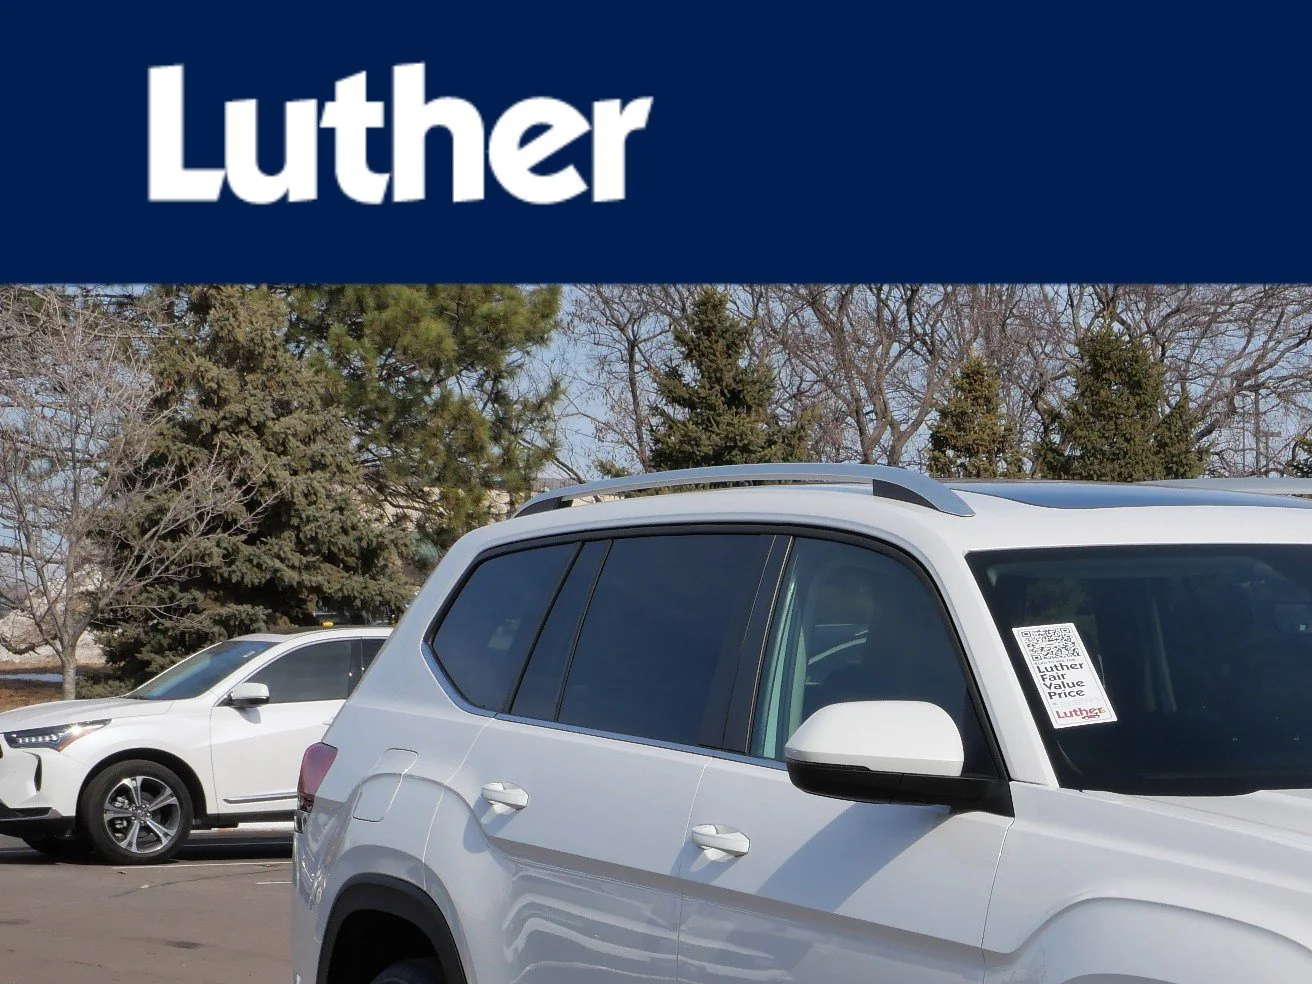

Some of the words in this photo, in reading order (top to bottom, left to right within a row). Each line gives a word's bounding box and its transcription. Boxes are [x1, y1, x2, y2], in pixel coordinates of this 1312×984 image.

[1036, 662, 1084, 674] Luther
[1039, 672, 1067, 683] Fair
[1043, 680, 1086, 691] Value
[1047, 689, 1086, 700] Price
[1055, 706, 1104, 719] Luther
